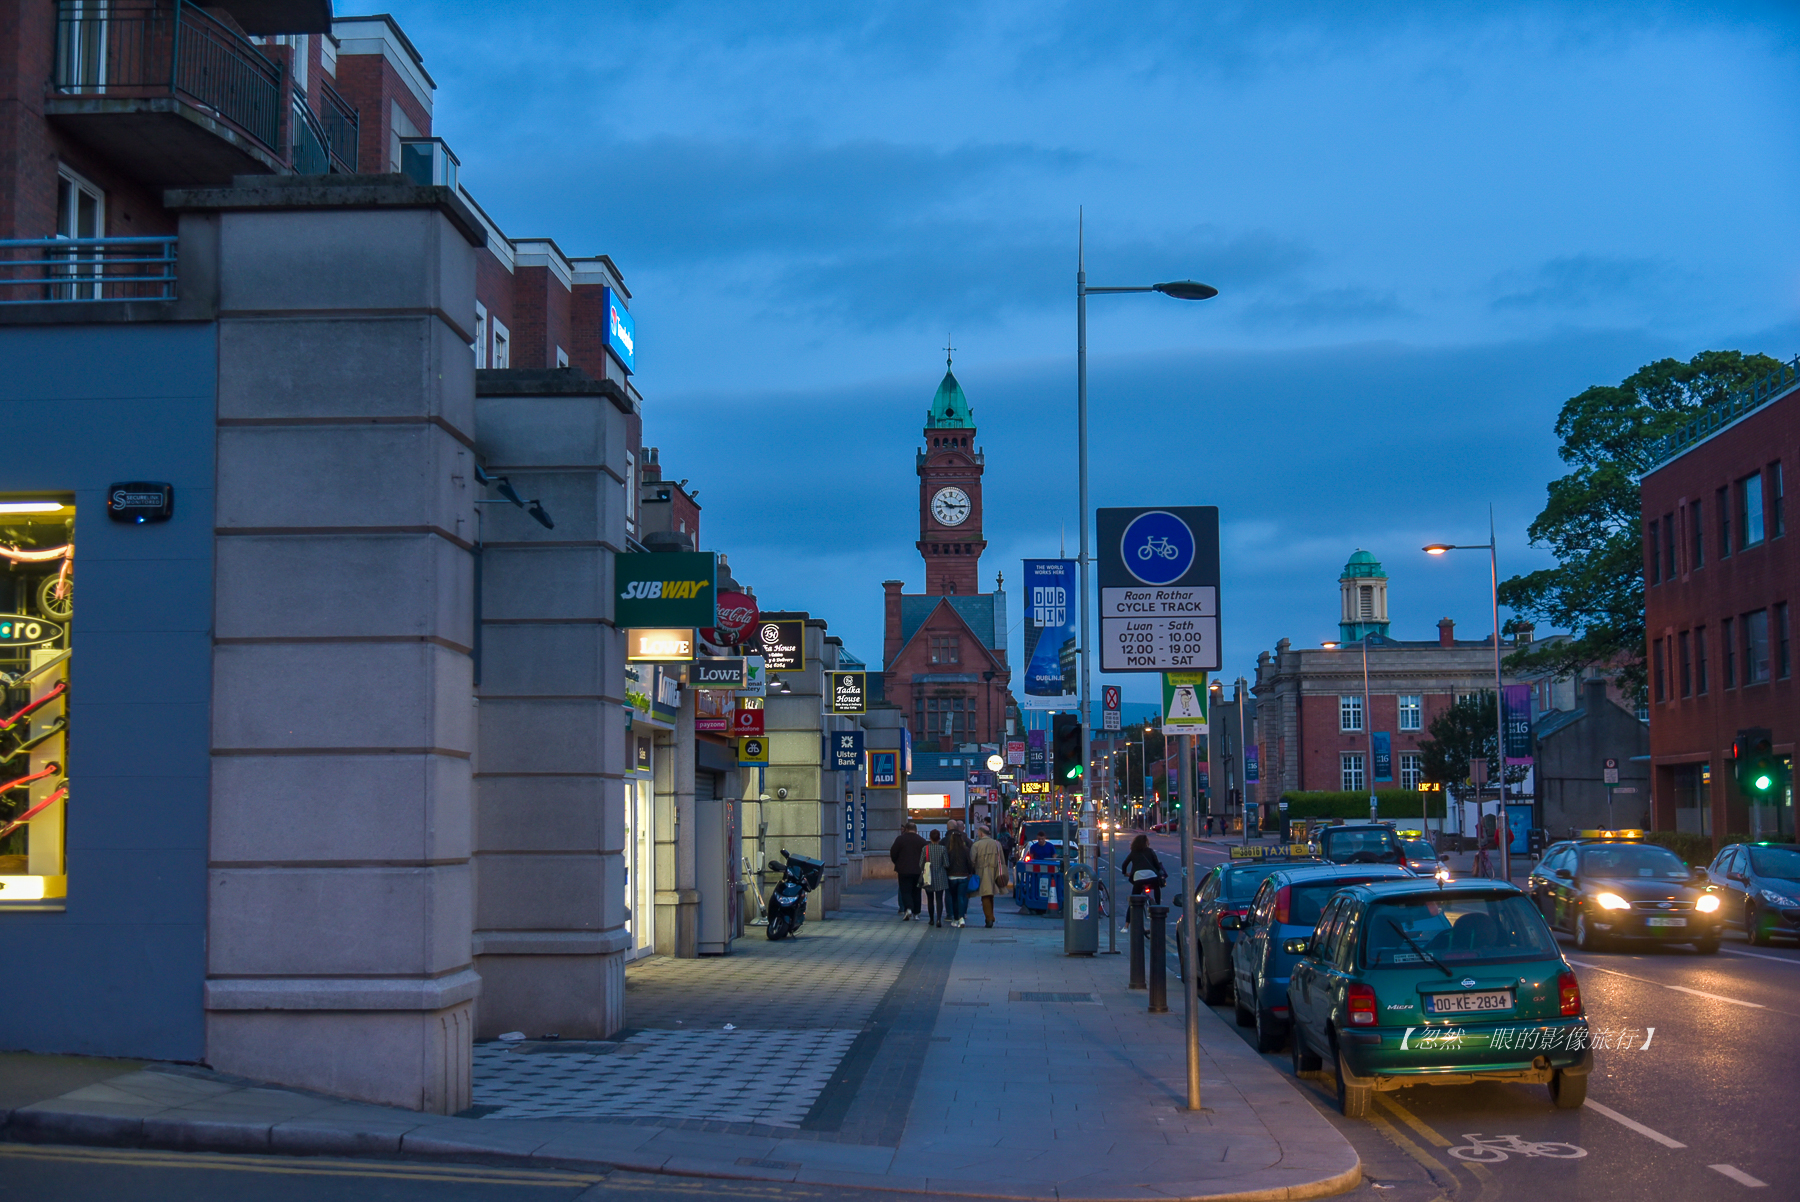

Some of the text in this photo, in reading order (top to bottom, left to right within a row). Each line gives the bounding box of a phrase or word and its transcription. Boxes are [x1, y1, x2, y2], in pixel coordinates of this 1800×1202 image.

[620, 579, 709, 599] SUBWAY
[1124, 590, 1194, 601] Raon Rothar
[1116, 601, 1202, 612] CYCLE TRACK
[0, 621, 42, 639] cro
[1126, 621, 1153, 631] Luan
[1167, 620, 1194, 630] Sath
[1118, 632, 1154, 643] 07.00
[1168, 632, 1202, 642] 10.00
[639, 637, 689, 654] LOWE
[773, 643, 797, 652] House
[1121, 644, 1154, 654] 12.00
[1168, 643, 1201, 654] 19.00
[1127, 656, 1156, 666] MON
[1171, 655, 1194, 665] SAT
[699, 667, 740, 681] LOWE
[836, 685, 861, 694] Tadka
[835, 695, 861, 703] House
[699, 721, 725, 729] payzone
[1516, 721, 1529, 733] 16
[874, 774, 894, 782] ALDI
[1264, 846, 1289, 856] TAXI
[1436, 995, 1506, 1012] 00-KE-2834
